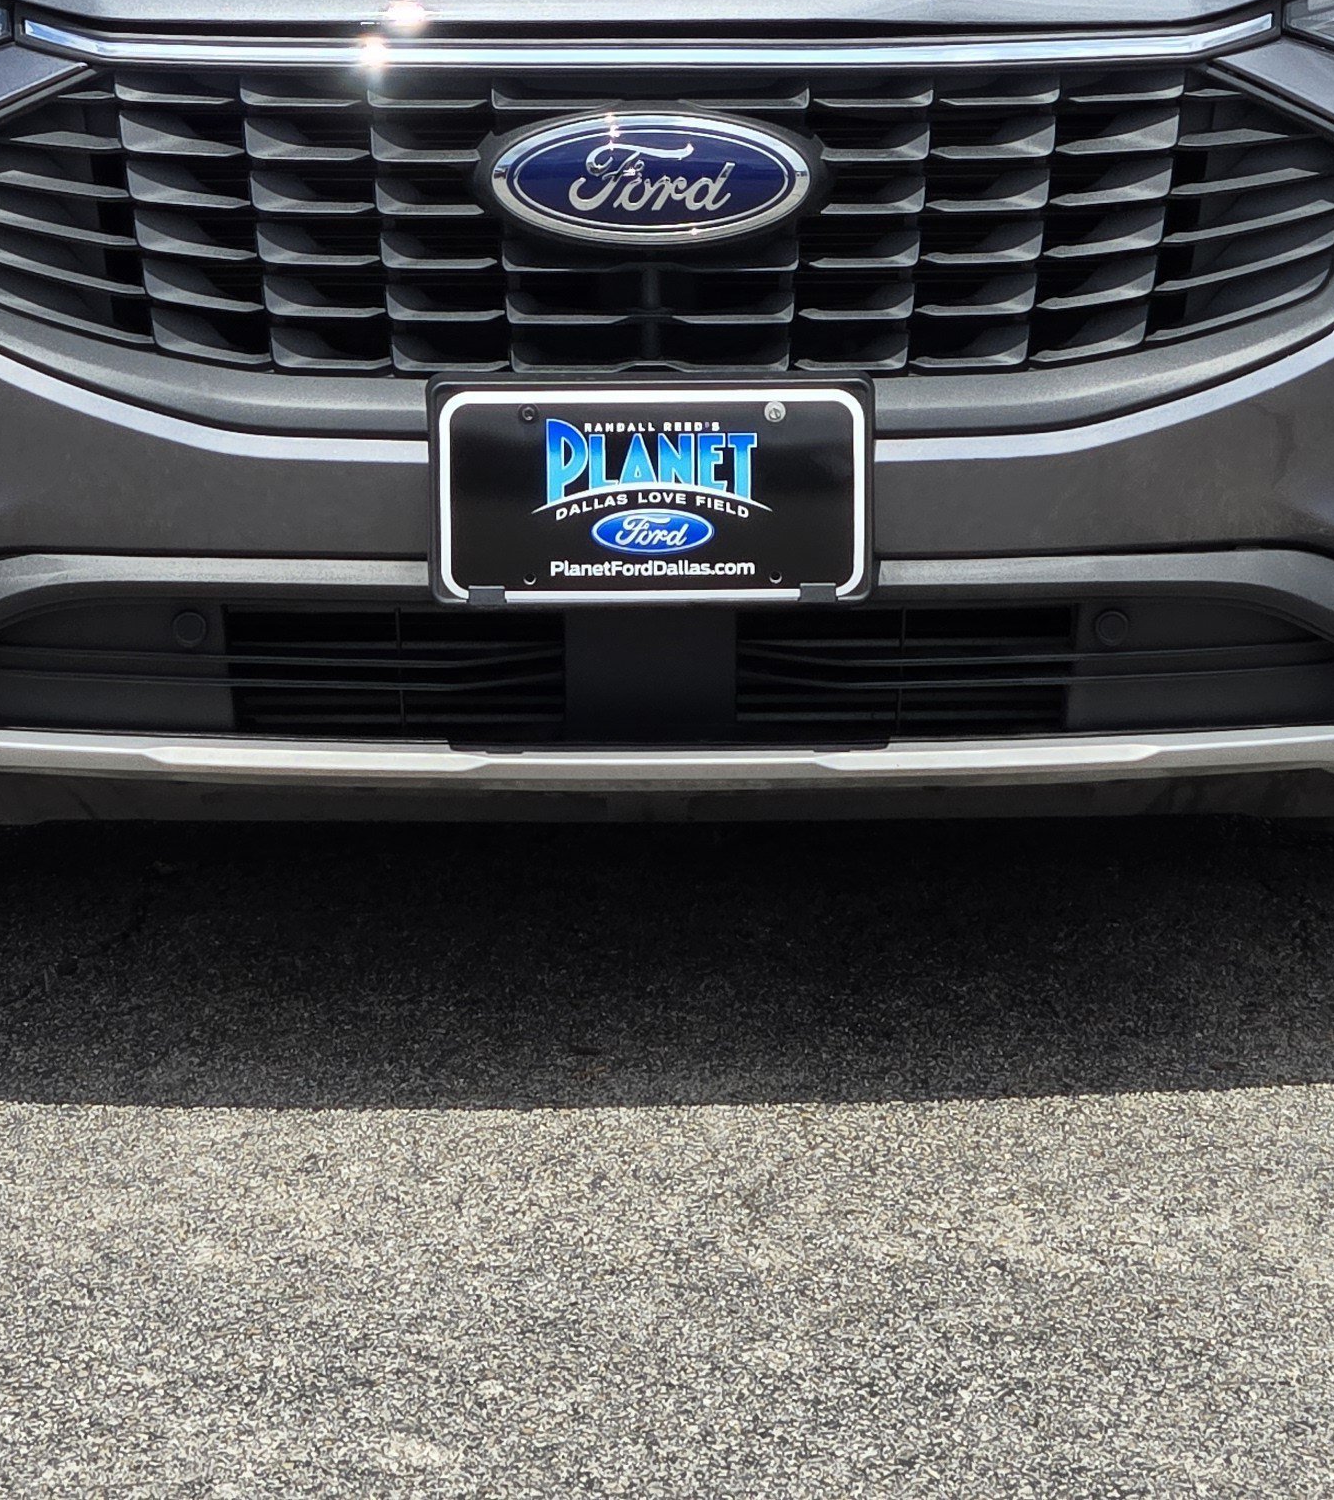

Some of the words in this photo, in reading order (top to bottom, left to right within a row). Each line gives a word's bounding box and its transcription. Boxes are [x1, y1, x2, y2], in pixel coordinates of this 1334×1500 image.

[568, 141, 736, 213] Ford
[584, 421, 656, 432] RANDALL
[546, 418, 758, 505] PLANET
[555, 491, 629, 521] DALLAS
[637, 491, 687, 504] LOVE
[696, 495, 750, 518] FIELD
[614, 515, 690, 546] Ford
[550, 560, 756, 577] PlanetFordDallas.com
